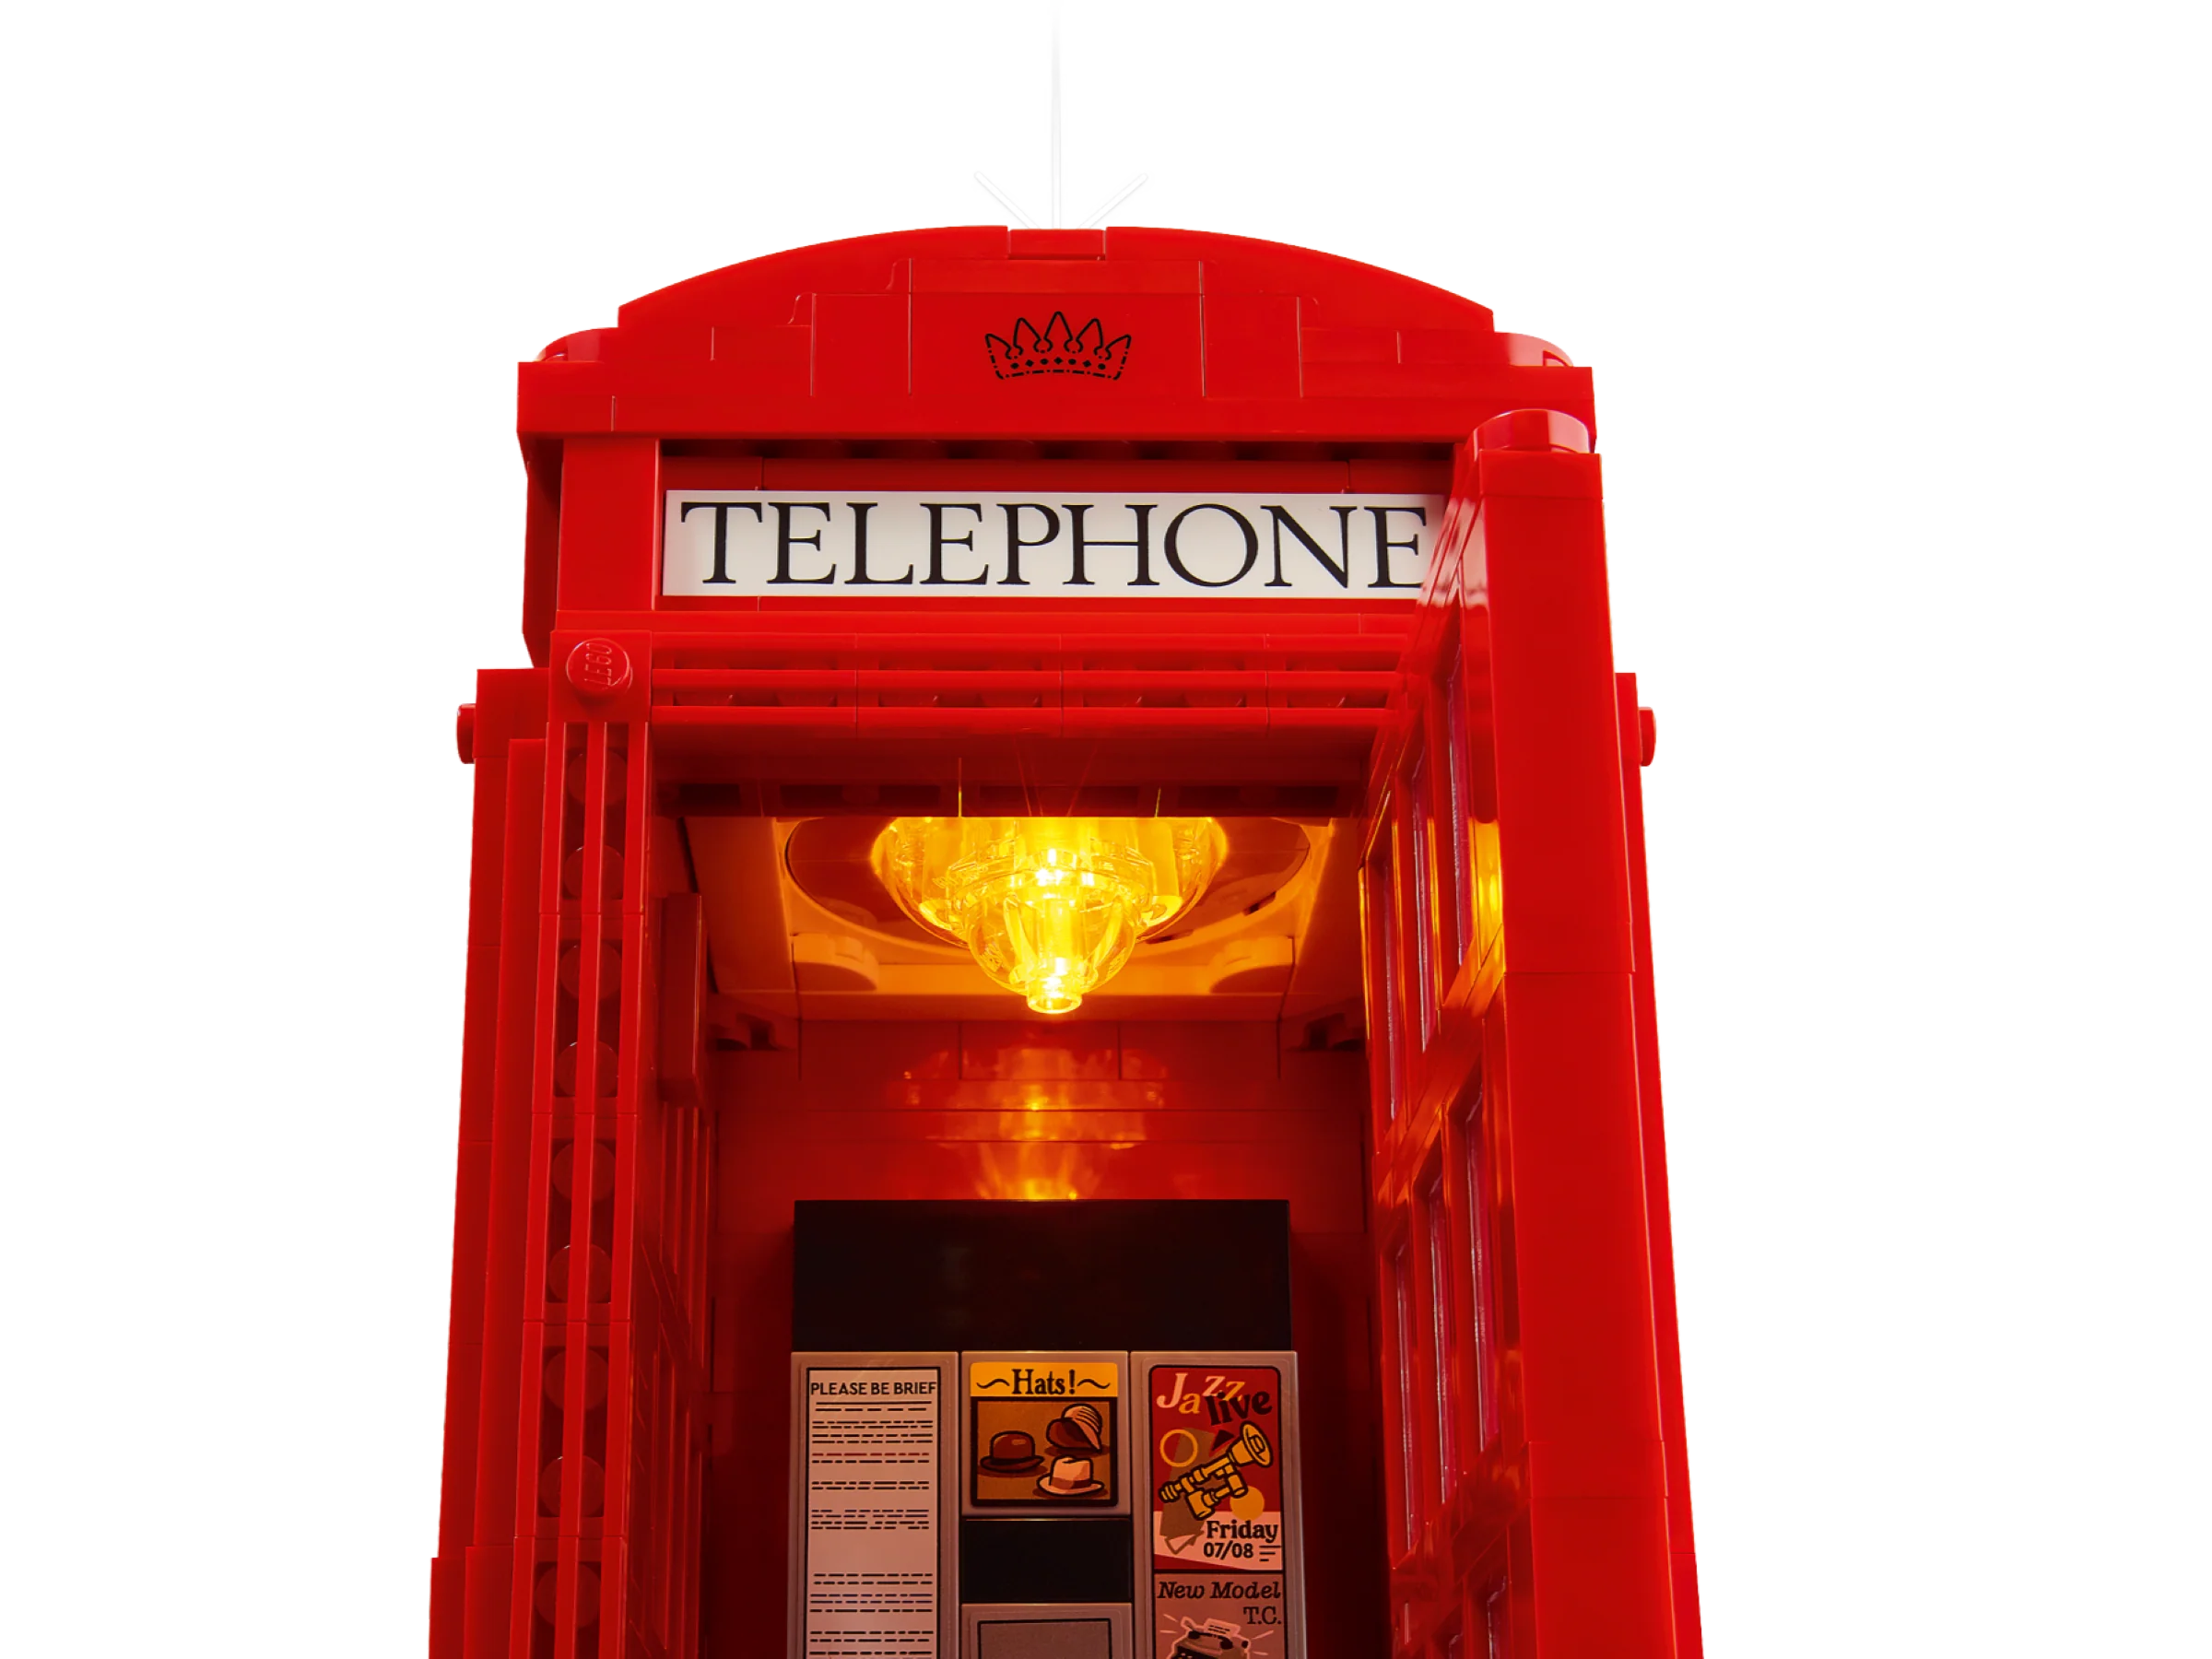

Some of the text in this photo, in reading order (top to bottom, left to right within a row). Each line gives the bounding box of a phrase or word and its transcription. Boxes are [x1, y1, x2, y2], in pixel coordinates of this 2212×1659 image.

[680, 501, 1428, 588] TELEPHONE
[584, 641, 612, 687] LEGO
[810, 1381, 937, 1395] PLEASE BE BRIEF
[1011, 1369, 1076, 1395] Hats!
[1156, 1372, 1246, 1415] Jazz
[1205, 1391, 1273, 1426] live
[1206, 1519, 1278, 1544] Friday
[1203, 1540, 1254, 1560] 07/08
[1157, 1581, 1281, 1599] New Model
[1242, 1606, 1282, 1625] T.C.
